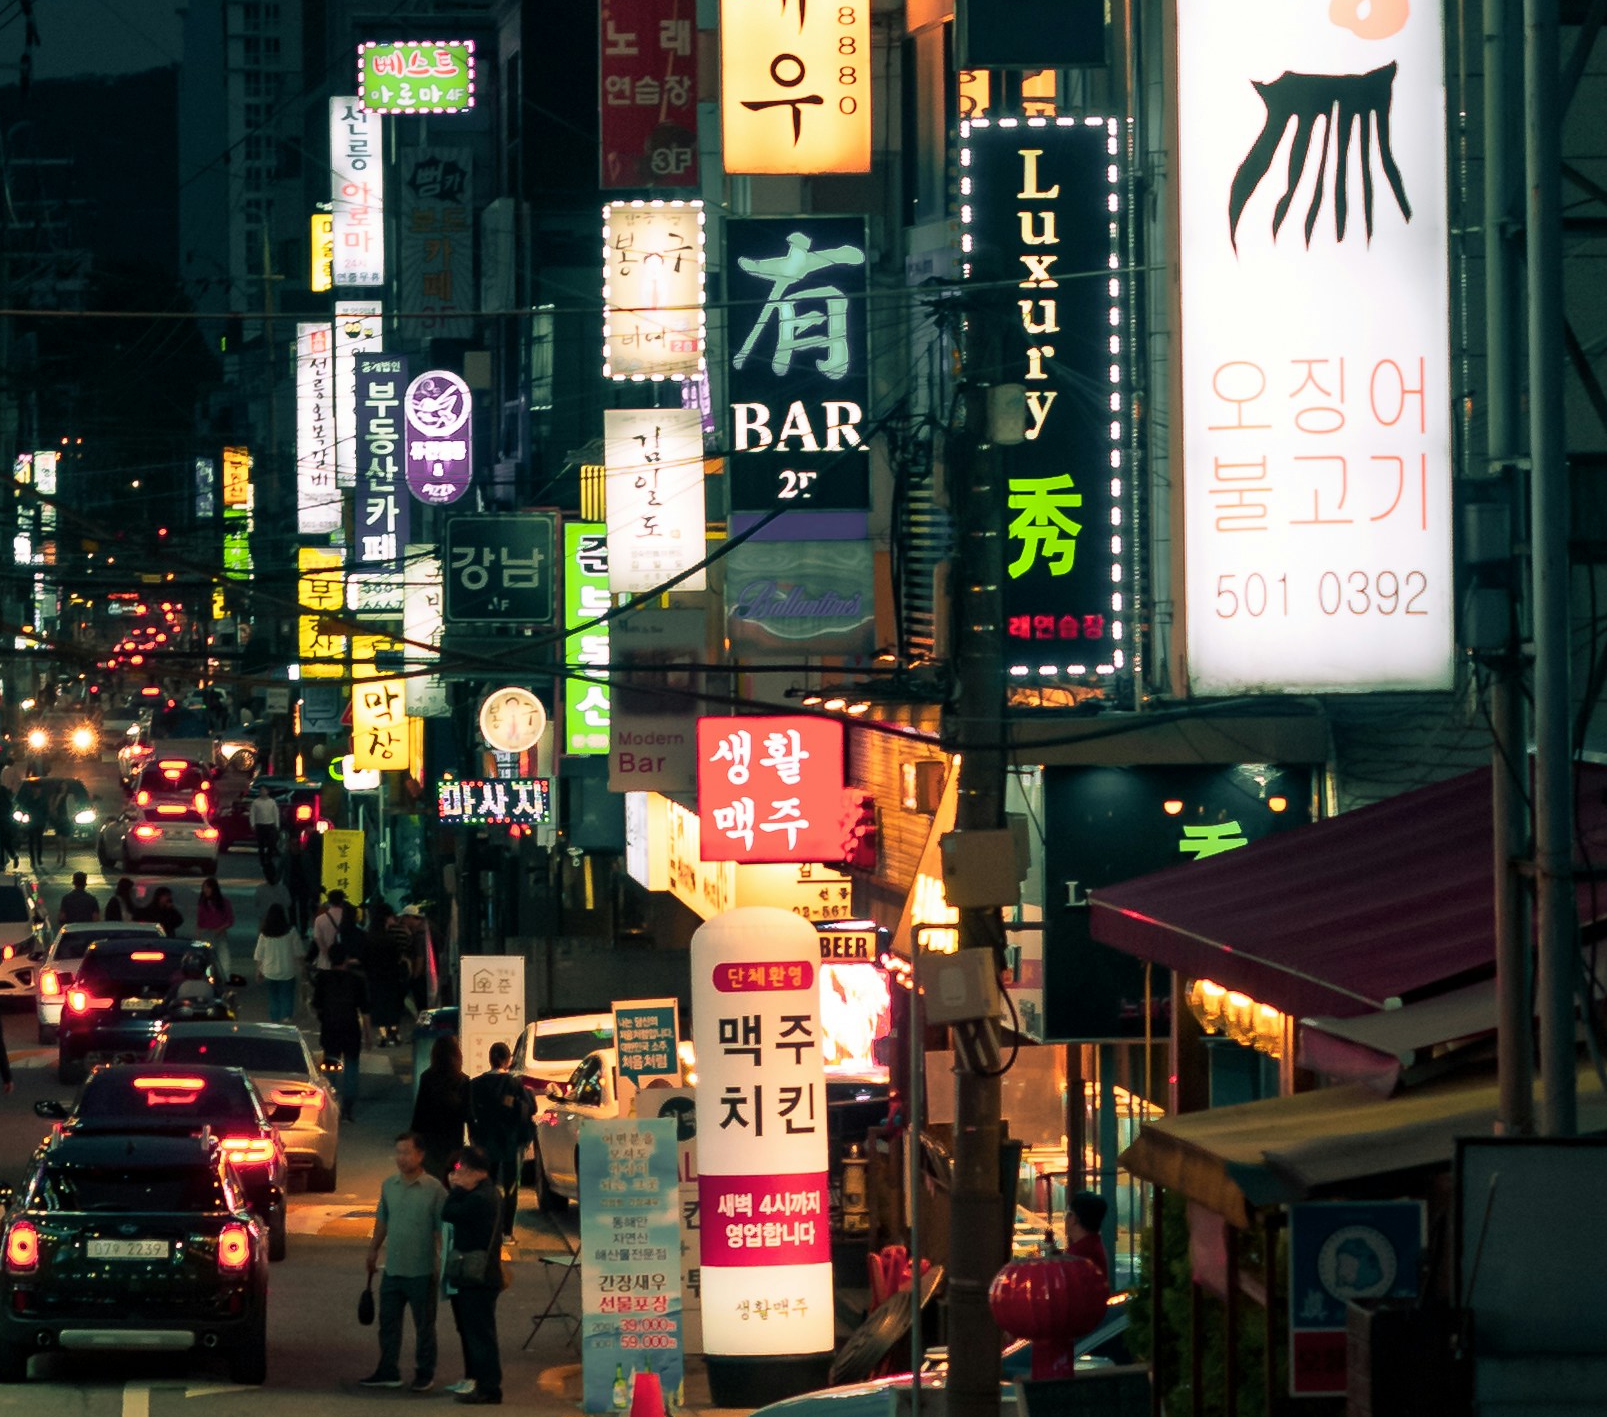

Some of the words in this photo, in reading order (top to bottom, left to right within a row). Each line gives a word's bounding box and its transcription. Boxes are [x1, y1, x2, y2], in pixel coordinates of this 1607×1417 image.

[605, 19, 691, 56] 노래
[372, 50, 460, 78] 베스트
[370, 82, 444, 106] 아로마
[445, 89, 465, 102] 4F
[604, 75, 692, 109] 연습장
[650, 148, 693, 176] 3F
[342, 180, 375, 253] 아로마
[733, 232, 866, 383] 有
[1017, 149, 1060, 441] Luxury
[1207, 355, 1427, 435] 오징어
[730, 399, 870, 453] BAR
[1208, 453, 1429, 534] 불고기
[1007, 473, 1083, 580] 秀
[451, 546, 545, 591] 강남
[1216, 572, 1292, 618] 501
[1317, 570, 1429, 617] 0392
[617, 730, 684, 747] Modern
[618, 753, 667, 774] Bar
[710, 729, 810, 788] 생활
[442, 783, 545, 818] 마사지
[712, 796, 810, 852] 맥주
[727, 965, 803, 988] 단체환영
[465, 1002, 522, 1025] 부동산
[718, 1014, 816, 1068] 맥주
[719, 1082, 817, 1137] 치킨
[717, 1194, 754, 1218] 새벽
[758, 1190, 821, 1217] 4시까지
[725, 1221, 816, 1249] 영업합니다
[598, 1273, 668, 1293] 간장새우
[599, 1295, 668, 1314] 선물포장
[735, 1295, 809, 1321] 생활맥주
